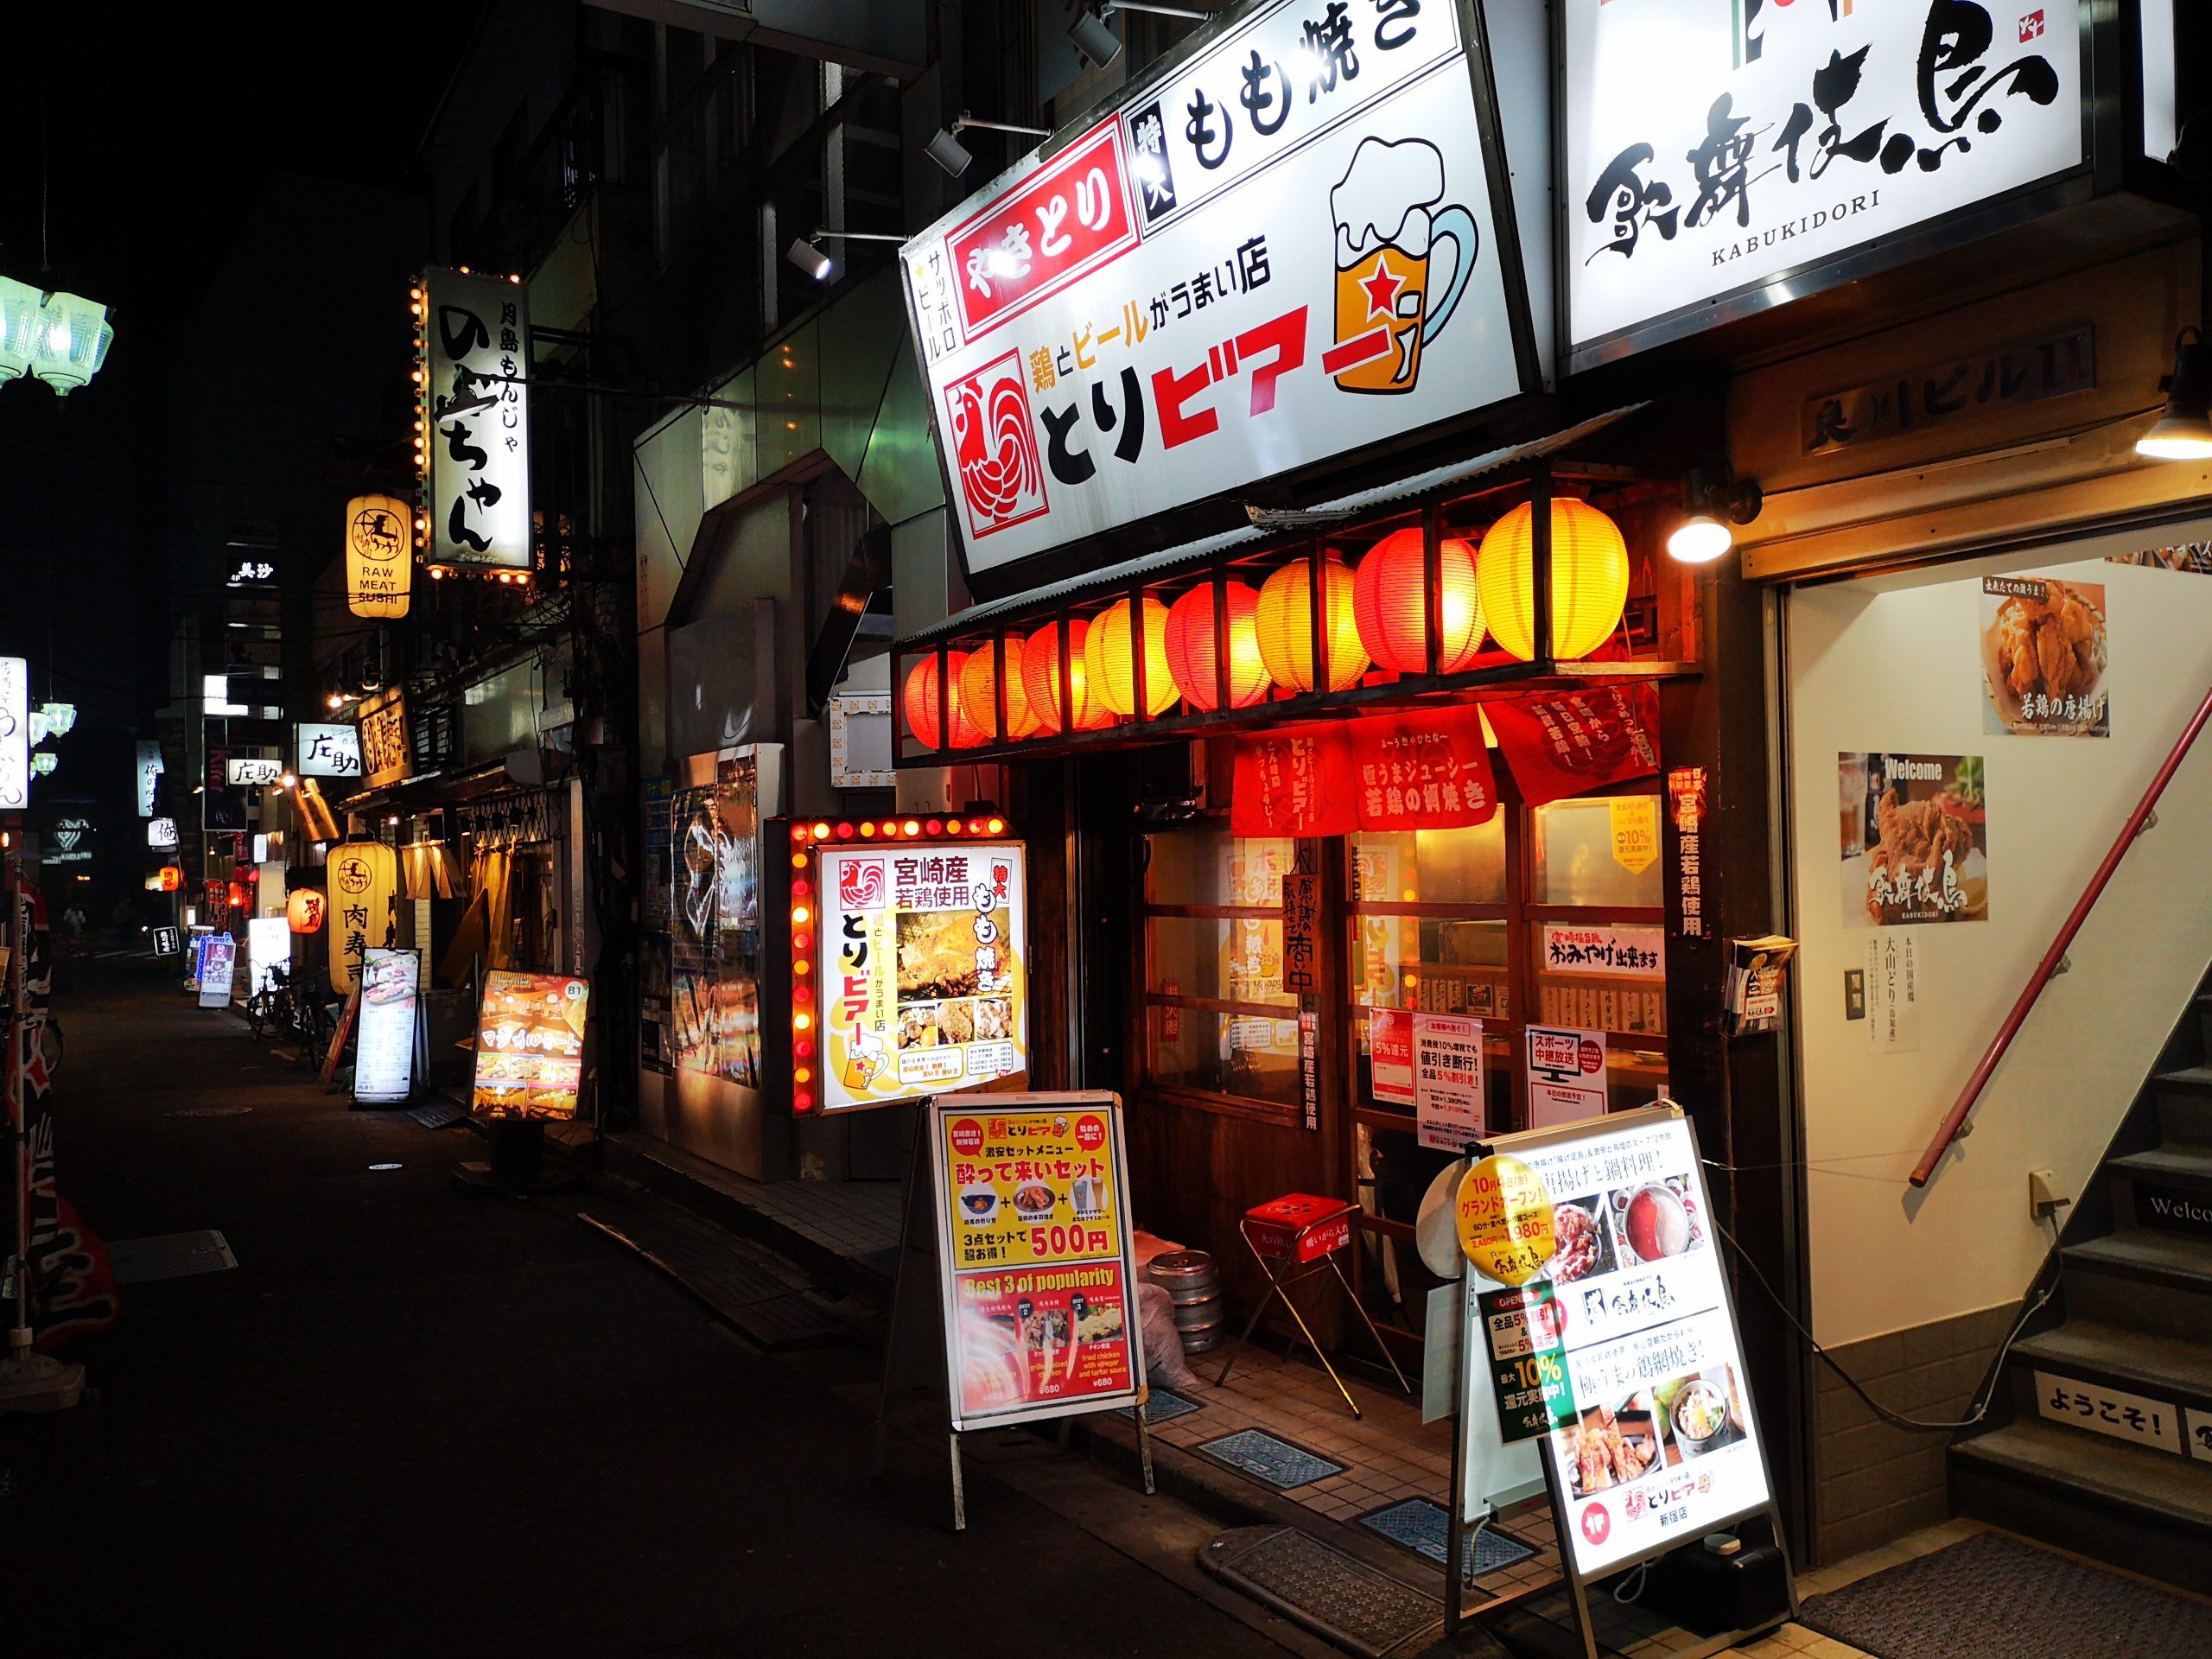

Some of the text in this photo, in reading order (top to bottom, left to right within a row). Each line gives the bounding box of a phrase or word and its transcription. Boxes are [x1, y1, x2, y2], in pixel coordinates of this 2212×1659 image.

[1712, 189, 1882, 267] KABUKIDORI
[926, 249, 957, 351] サッポロ
[918, 288, 942, 362] ビール
[1029, 233, 1272, 395] 鶏とビールがうまい店
[1039, 303, 1393, 486] とりビアー
[362, 566, 394, 577] RAW
[359, 580, 397, 591] MEAT
[359, 592, 397, 605] SUSHI
[2020, 691, 2107, 721] 若鶏の唐揚げ
[307, 734, 359, 773] 庄助
[235, 761, 277, 782] 庄助
[1363, 757, 1478, 785] 極うまジューシー
[1885, 759, 1942, 782] Welcome
[1291, 738, 1307, 831] とりビアー
[1365, 779, 1486, 817] 若鶏の網焼き
[1625, 830, 1651, 844] 10%
[894, 855, 969, 887] 宮崎産
[1679, 793, 1702, 936] 宮崎産若鶏使用
[993, 865, 1008, 899] 特大
[895, 886, 970, 910] 若鶏使用
[972, 883, 998, 993] もも焼き
[1550, 938, 1658, 968] おみやげ出来ます
[842, 913, 871, 1046] とりビアー
[873, 913, 887, 1033] 鶏とビールがうまい店
[567, 986, 582, 995] B1
[1376, 1042, 1408, 1058] 5%還元
[1421, 1039, 1478, 1054] 消費税10%増税でも
[1535, 1035, 1573, 1050] スポーツ
[1421, 1050, 1478, 1071] 値引き断行！
[1535, 1048, 1574, 1065] 中継放送
[1421, 1068, 1478, 1086] 全品5%割引き！
[985, 1145, 1074, 1158] 激安セットメニュー
[955, 1157, 1105, 1185] 酔って来いセット
[1462, 1192, 1544, 1218] グランドオープン！
[963, 1230, 1027, 1247] 3点セットで
[1031, 1224, 1109, 1257] 500円
[964, 1246, 1007, 1262] 超お得！
[965, 1268, 1115, 1296] Best 3 of popularity
[1521, 1326, 1529, 1337] &
[1082, 1351, 1121, 1362] fried chicken
[1096, 1359, 1121, 1369] vinegar
[1078, 1370, 1091, 1379] and
[1109, 1366, 1128, 1375] sauce
[1092, 1377, 1113, 1388] ¥680
[1514, 1352, 1562, 1389] 10%
[2049, 1386, 2163, 1435] ようこそ！
[1585, 1512, 1605, 1535] 1F
[1659, 1506, 1688, 1527] 新宿店
